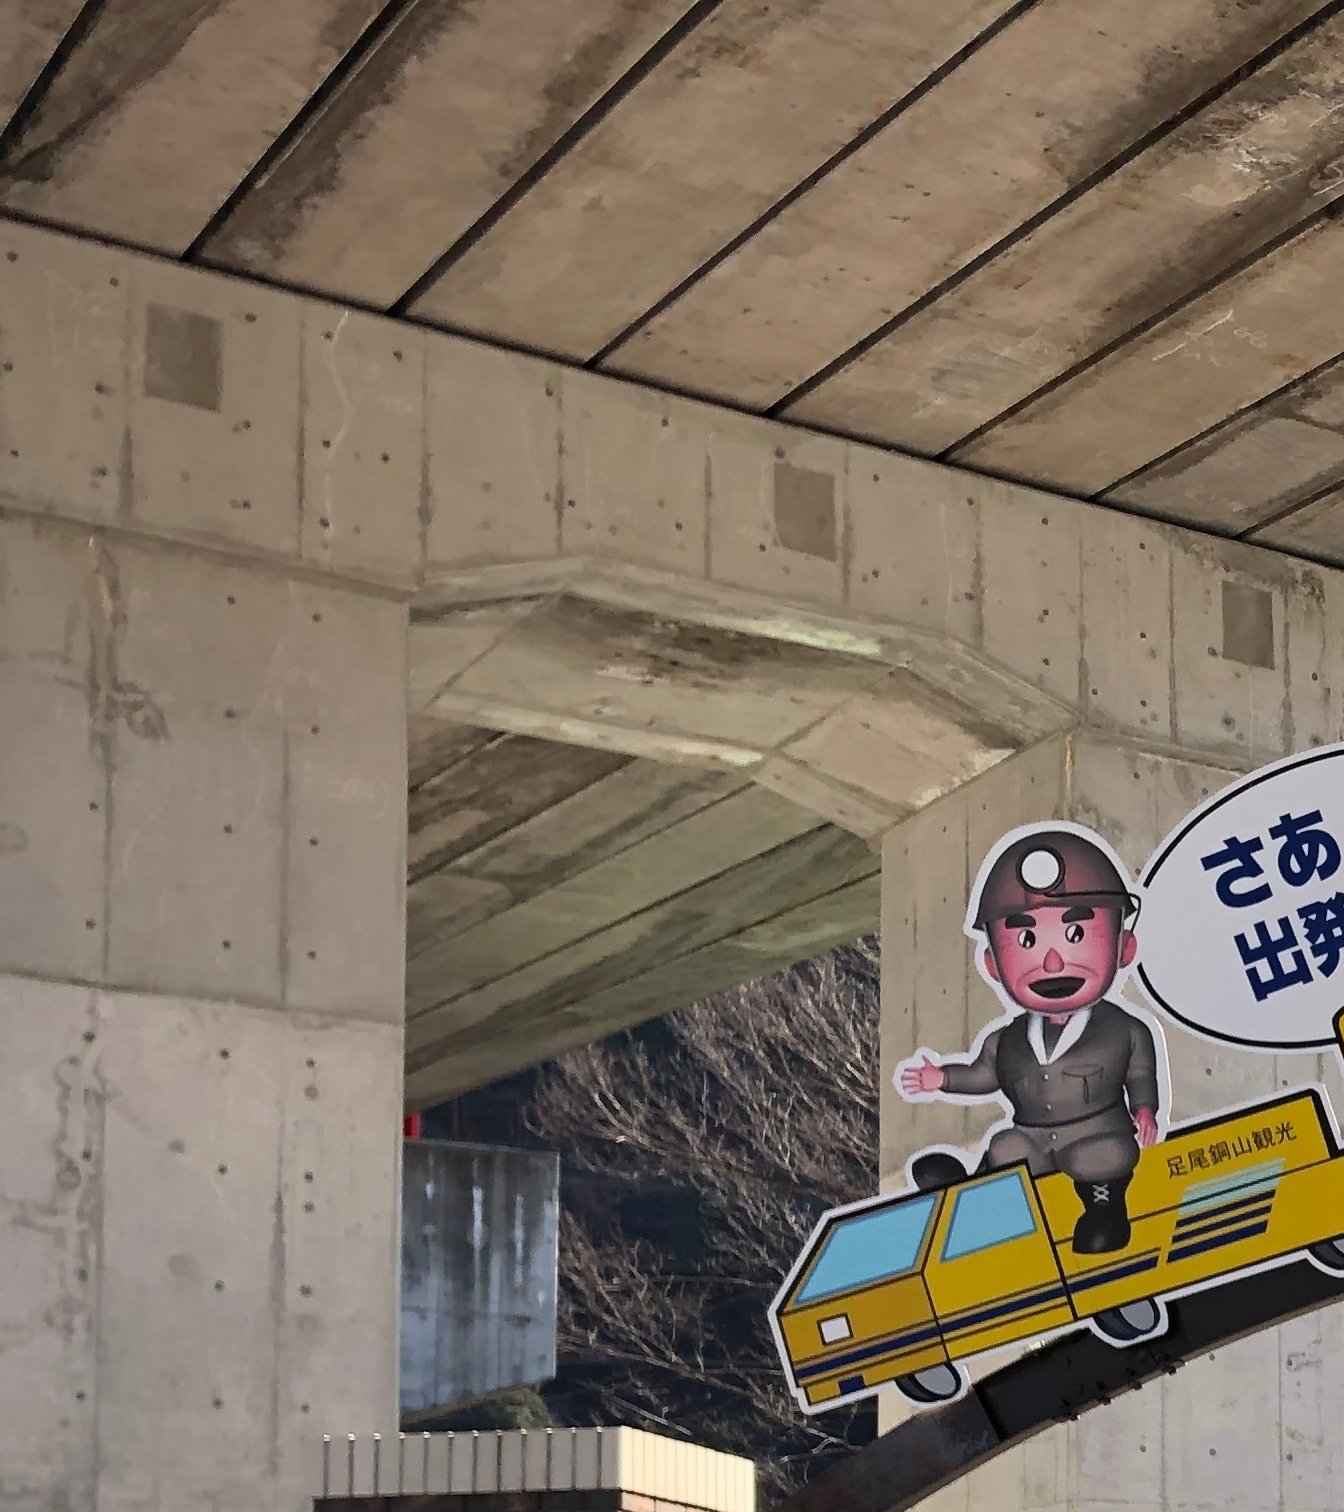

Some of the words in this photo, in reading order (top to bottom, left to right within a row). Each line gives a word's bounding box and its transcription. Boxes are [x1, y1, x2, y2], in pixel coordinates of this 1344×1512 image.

[1166, 1121, 1297, 1179] 足尾銅山観光
